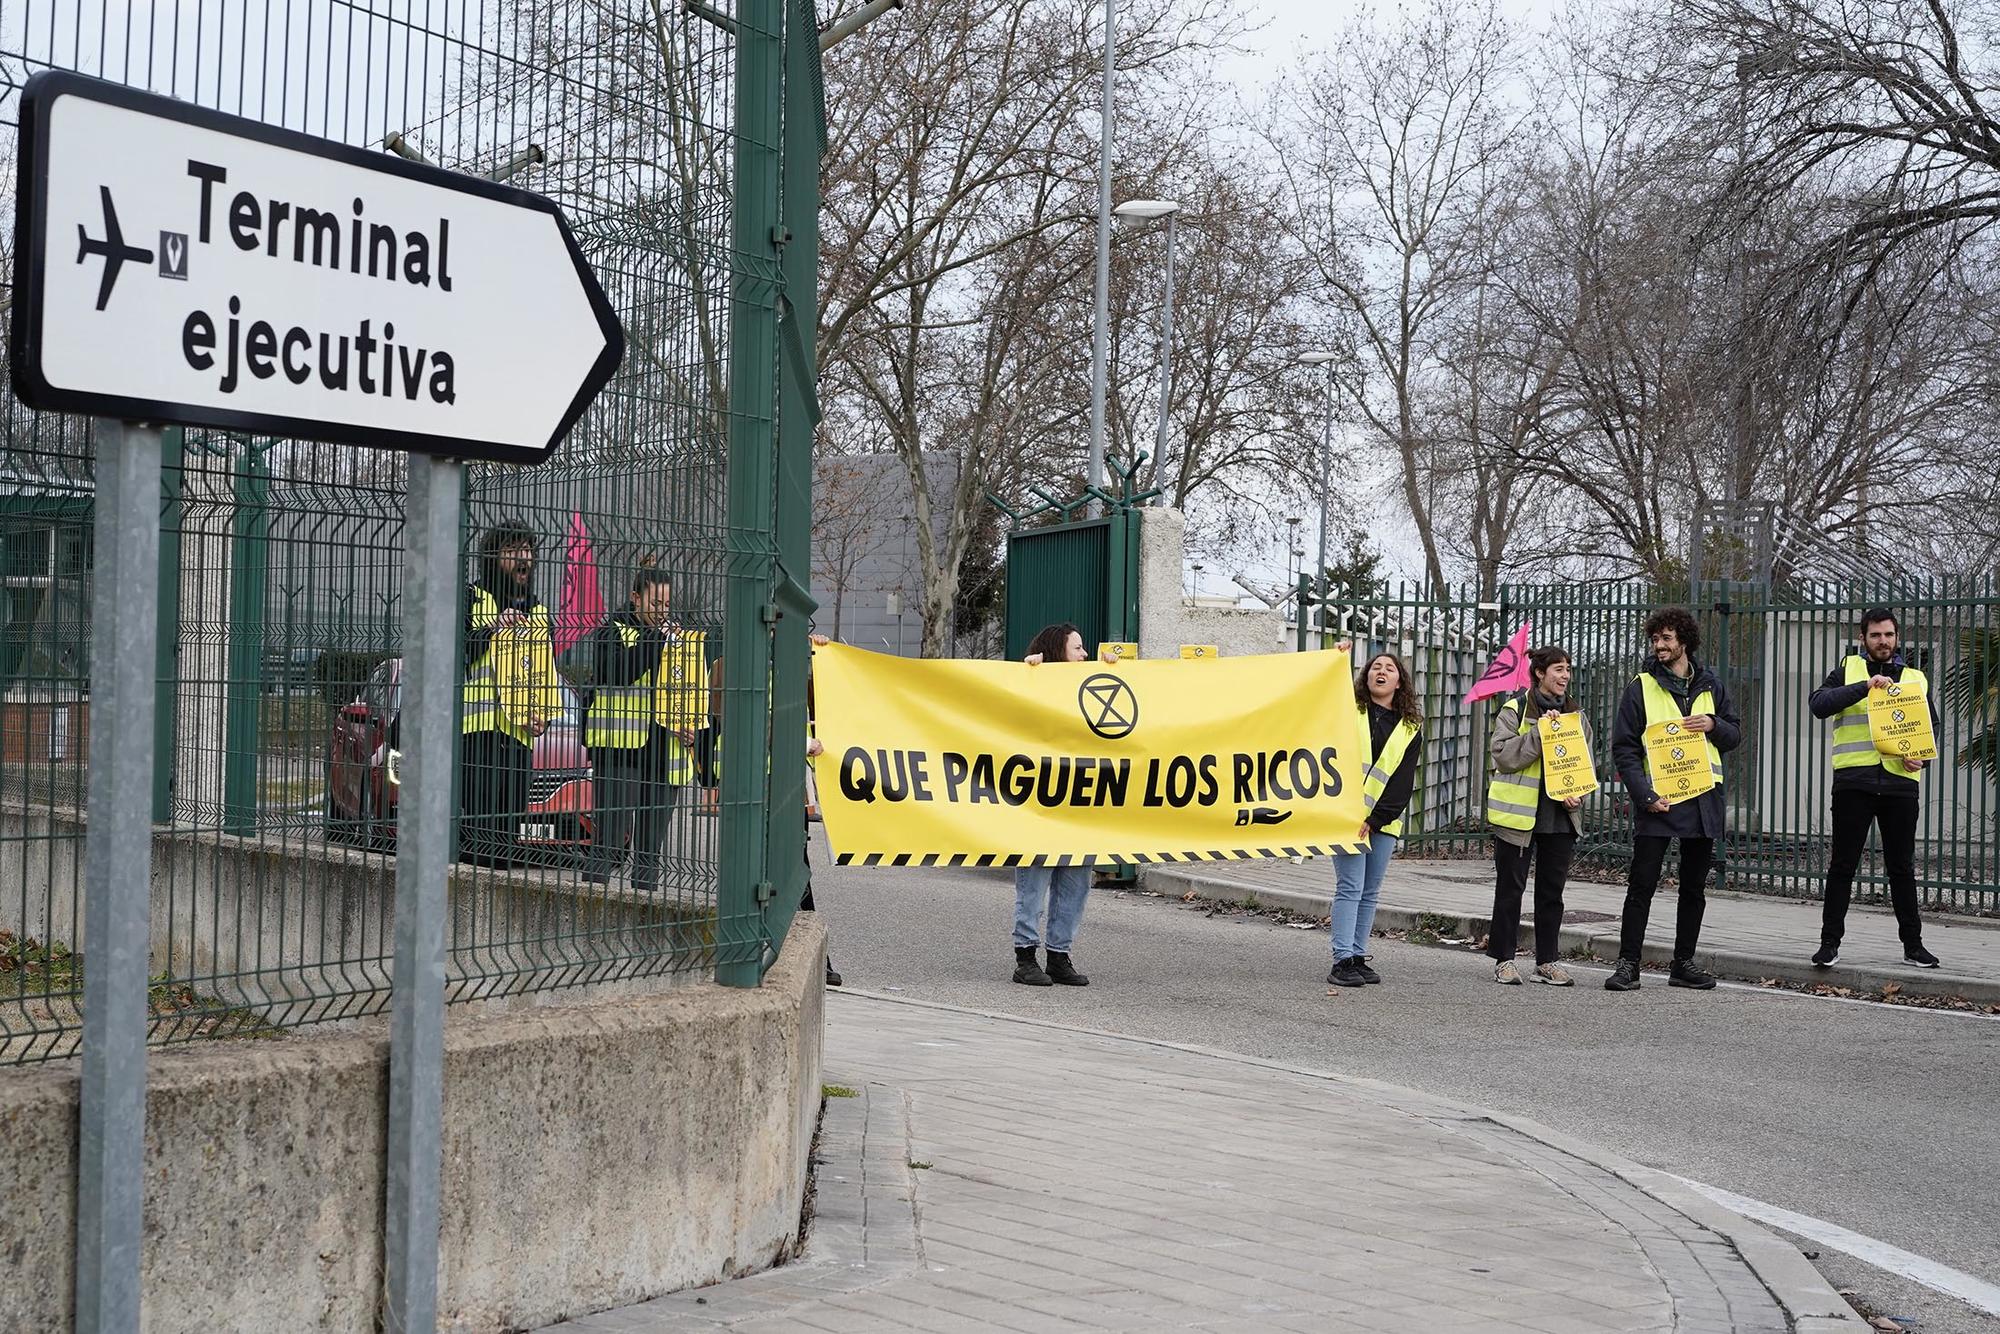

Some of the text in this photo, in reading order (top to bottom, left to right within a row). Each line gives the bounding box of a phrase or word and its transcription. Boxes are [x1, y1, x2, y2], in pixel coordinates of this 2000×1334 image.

[187, 159, 452, 292] Terminal
[182, 295, 457, 407] ejecutiva
[1885, 698, 1896, 706] JETS
[1897, 695, 1921, 704] PRIVADOS
[1898, 720, 1921, 729] VIAJEROS
[1557, 730, 1579, 738] PRIVADOS
[1887, 727, 1916, 736] FRECUENTES
[1676, 733, 1700, 742] PRIVADOS
[1560, 755, 1581, 764] VIAJEROS
[1678, 758, 1700, 767] VIAJEROS
[1667, 766, 1695, 774] FRECUENTES
[838, 745, 1343, 808] QUE PAGUEN LOS RICOS
